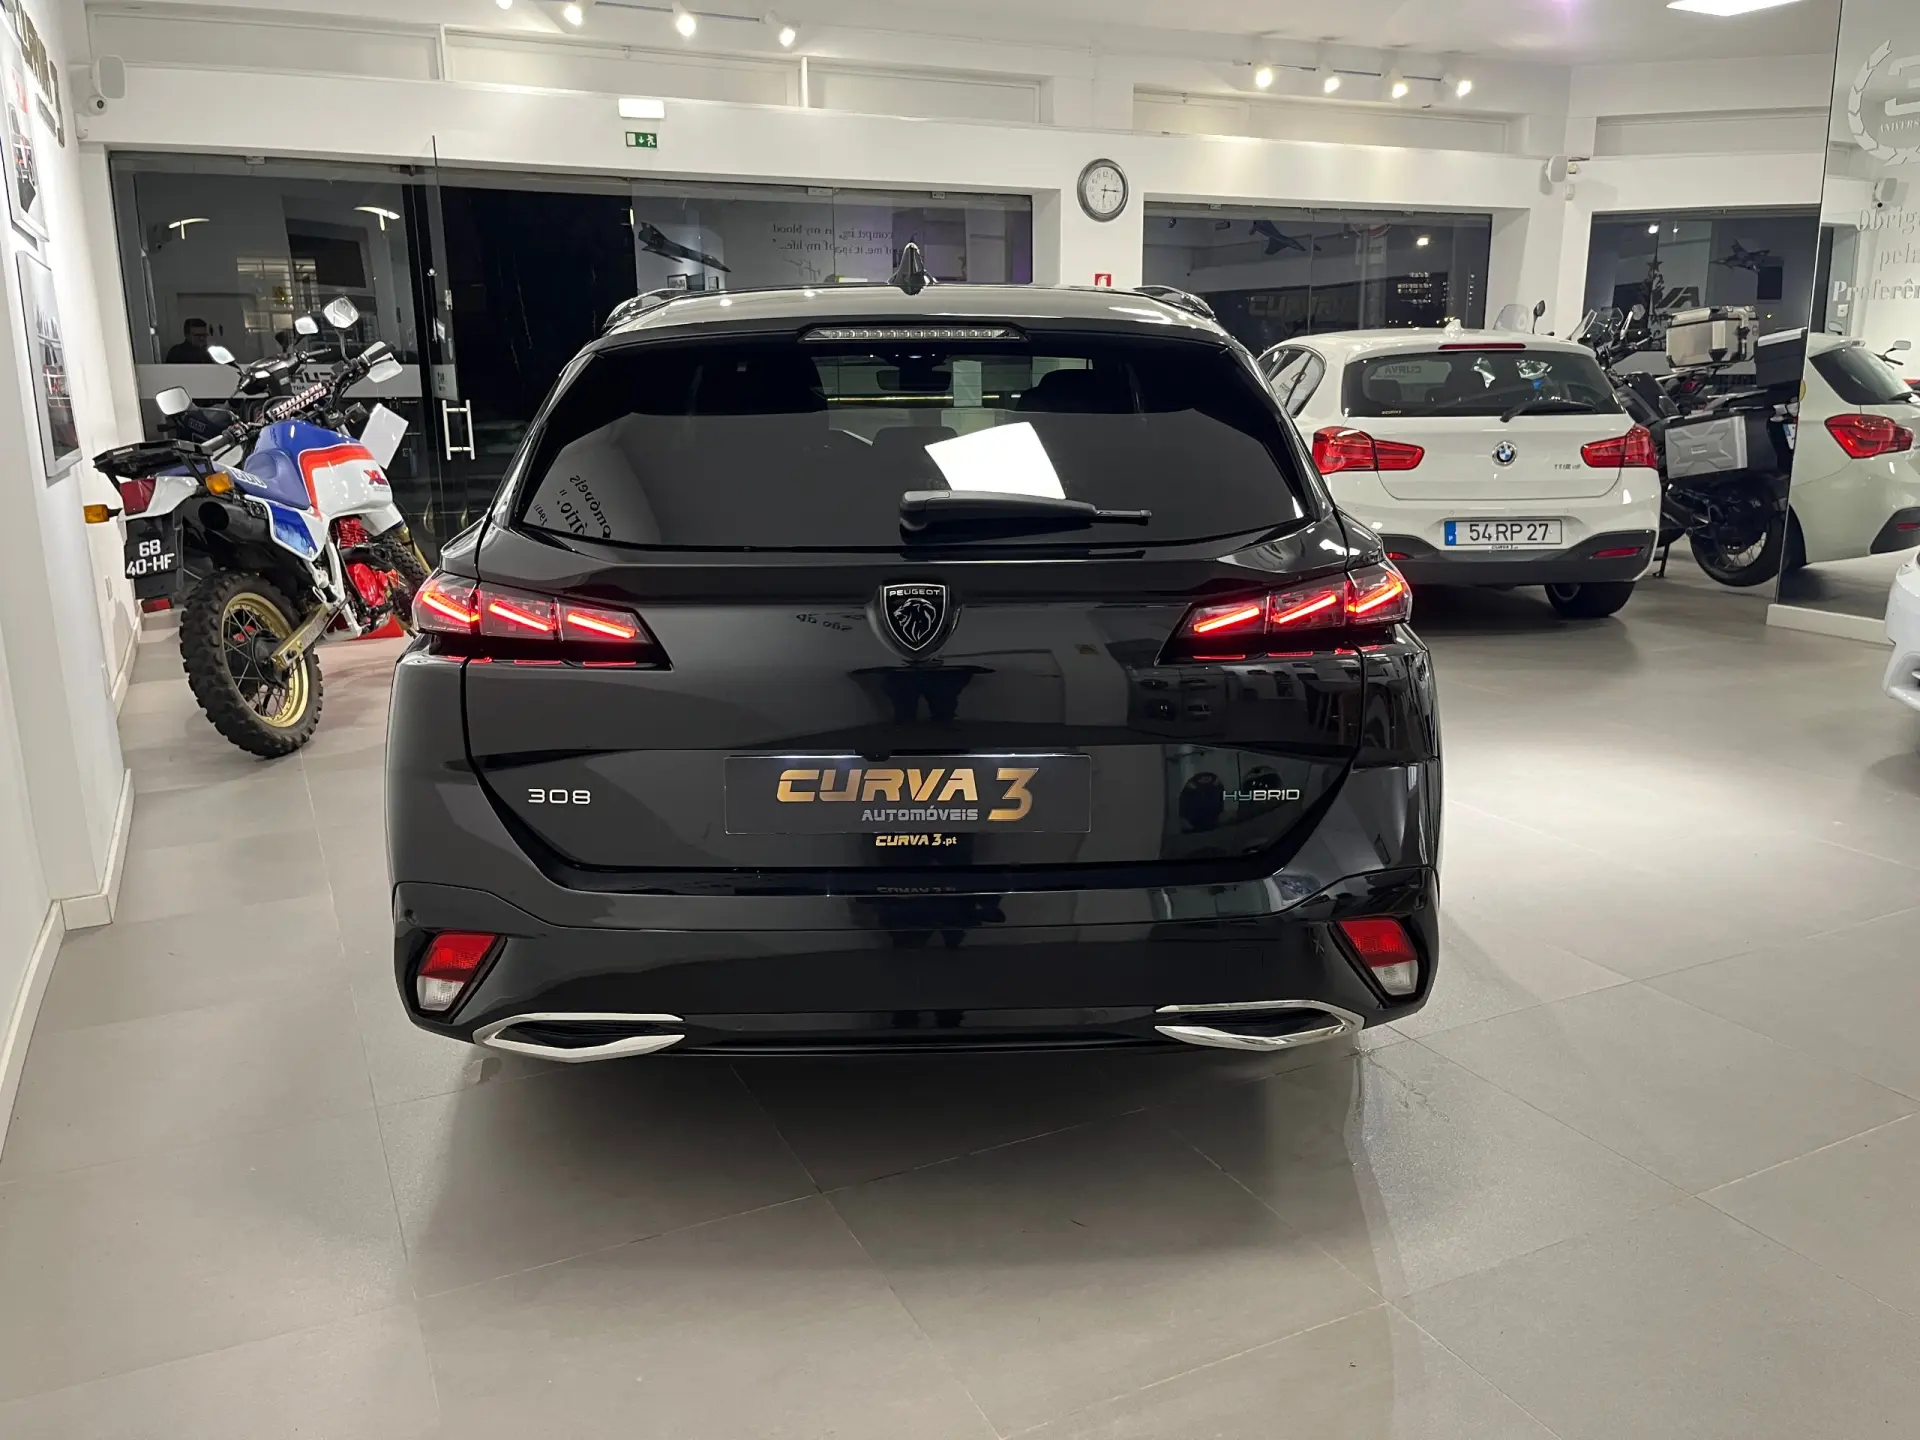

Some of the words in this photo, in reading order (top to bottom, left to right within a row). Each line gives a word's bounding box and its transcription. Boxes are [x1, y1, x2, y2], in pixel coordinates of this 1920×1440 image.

[1879, 118, 1920, 134] ANIVERS
[1858, 206, 1920, 234] Obrig
[126, 552, 175, 576] 40-HF
[889, 589, 940, 597] PEUGEOT
[527, 788, 592, 805] 308
[775, 768, 979, 802] CURVA
[987, 767, 1039, 822] 3
[1223, 789, 1299, 802] HYBRID
[861, 805, 979, 822] AUTOMÓVEIS
[875, 835, 929, 847] CURVA
